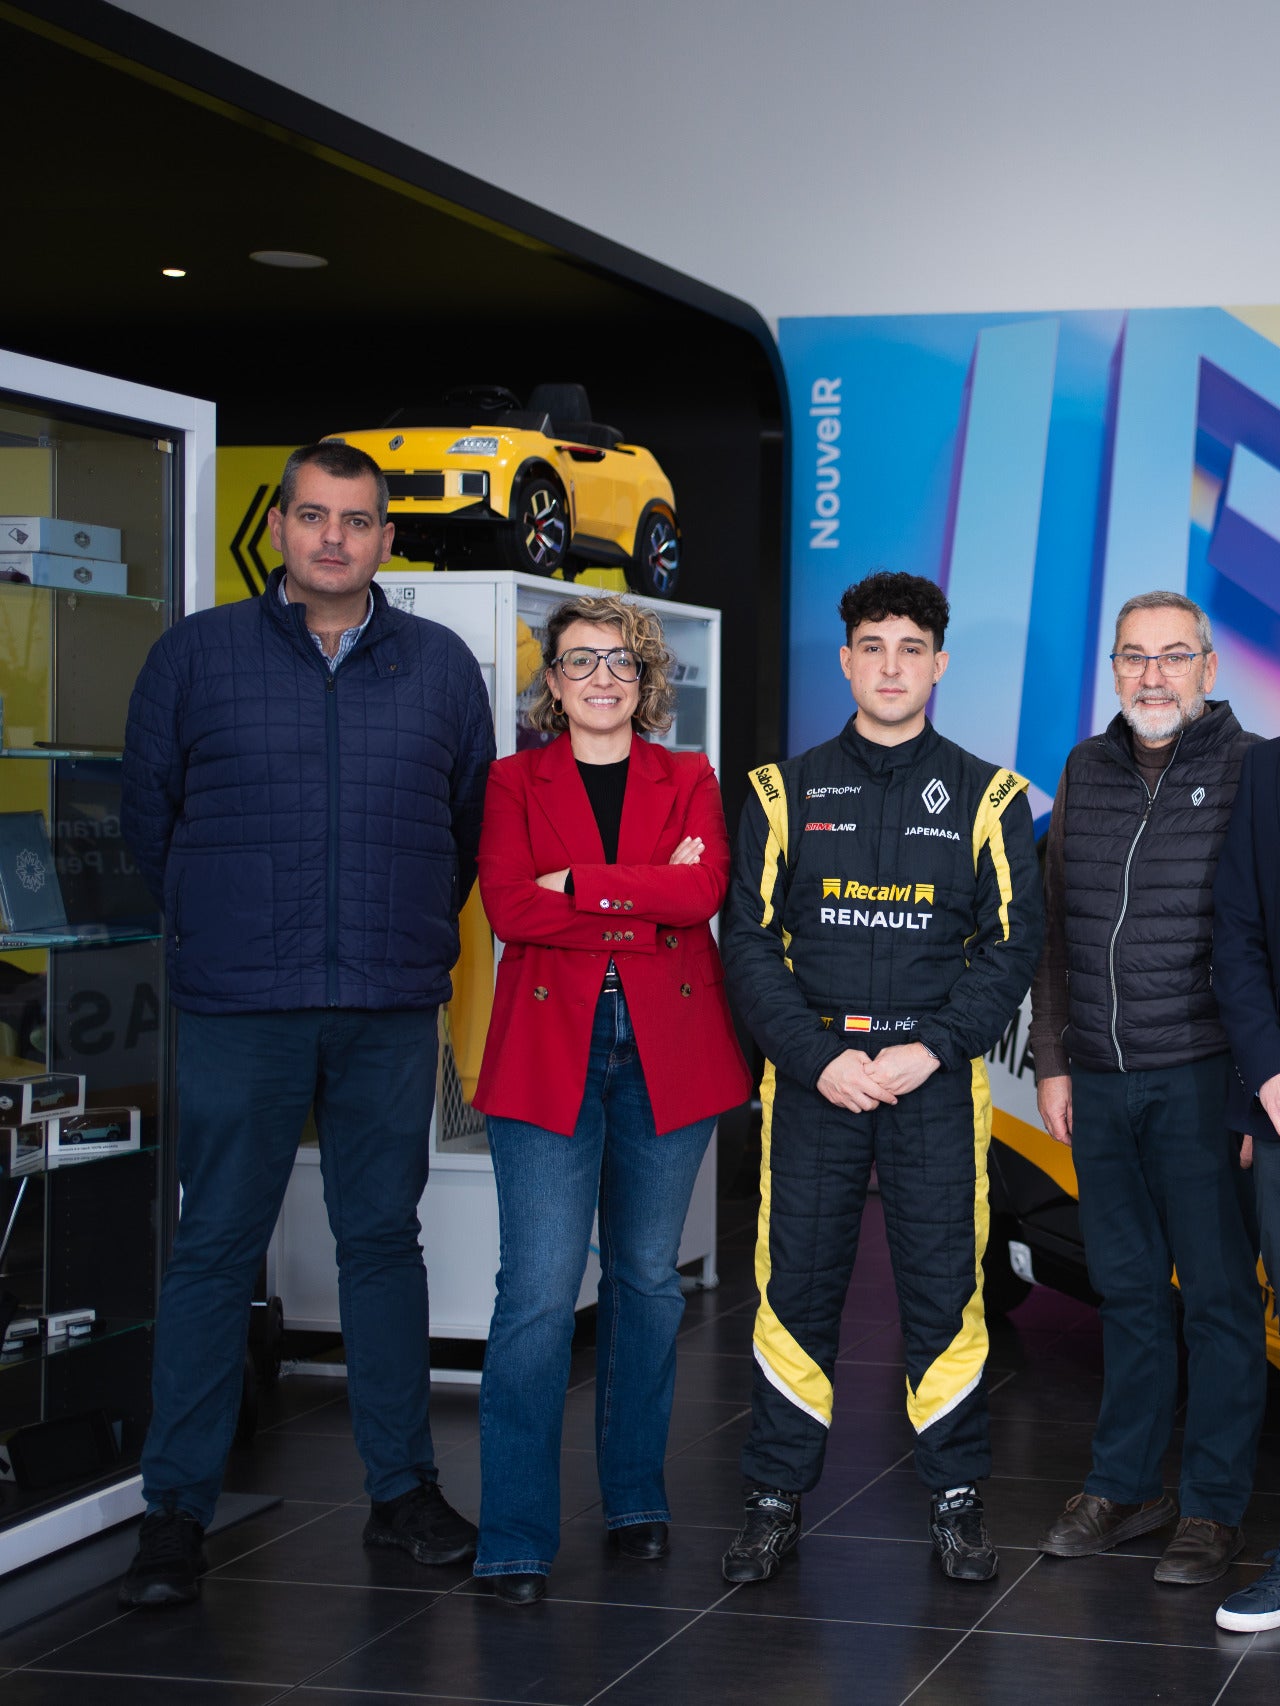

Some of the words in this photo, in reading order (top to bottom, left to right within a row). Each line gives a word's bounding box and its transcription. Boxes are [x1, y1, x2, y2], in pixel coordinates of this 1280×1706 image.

[809, 376, 842, 549] NouvelR
[755, 767, 780, 803] Sabelt
[989, 773, 1018, 808] Sabelt
[904, 826, 960, 841] JAPEMASA
[844, 880, 912, 902] Recalvi
[820, 907, 933, 930] RENAULT
[872, 1020, 892, 1031] J.J.
